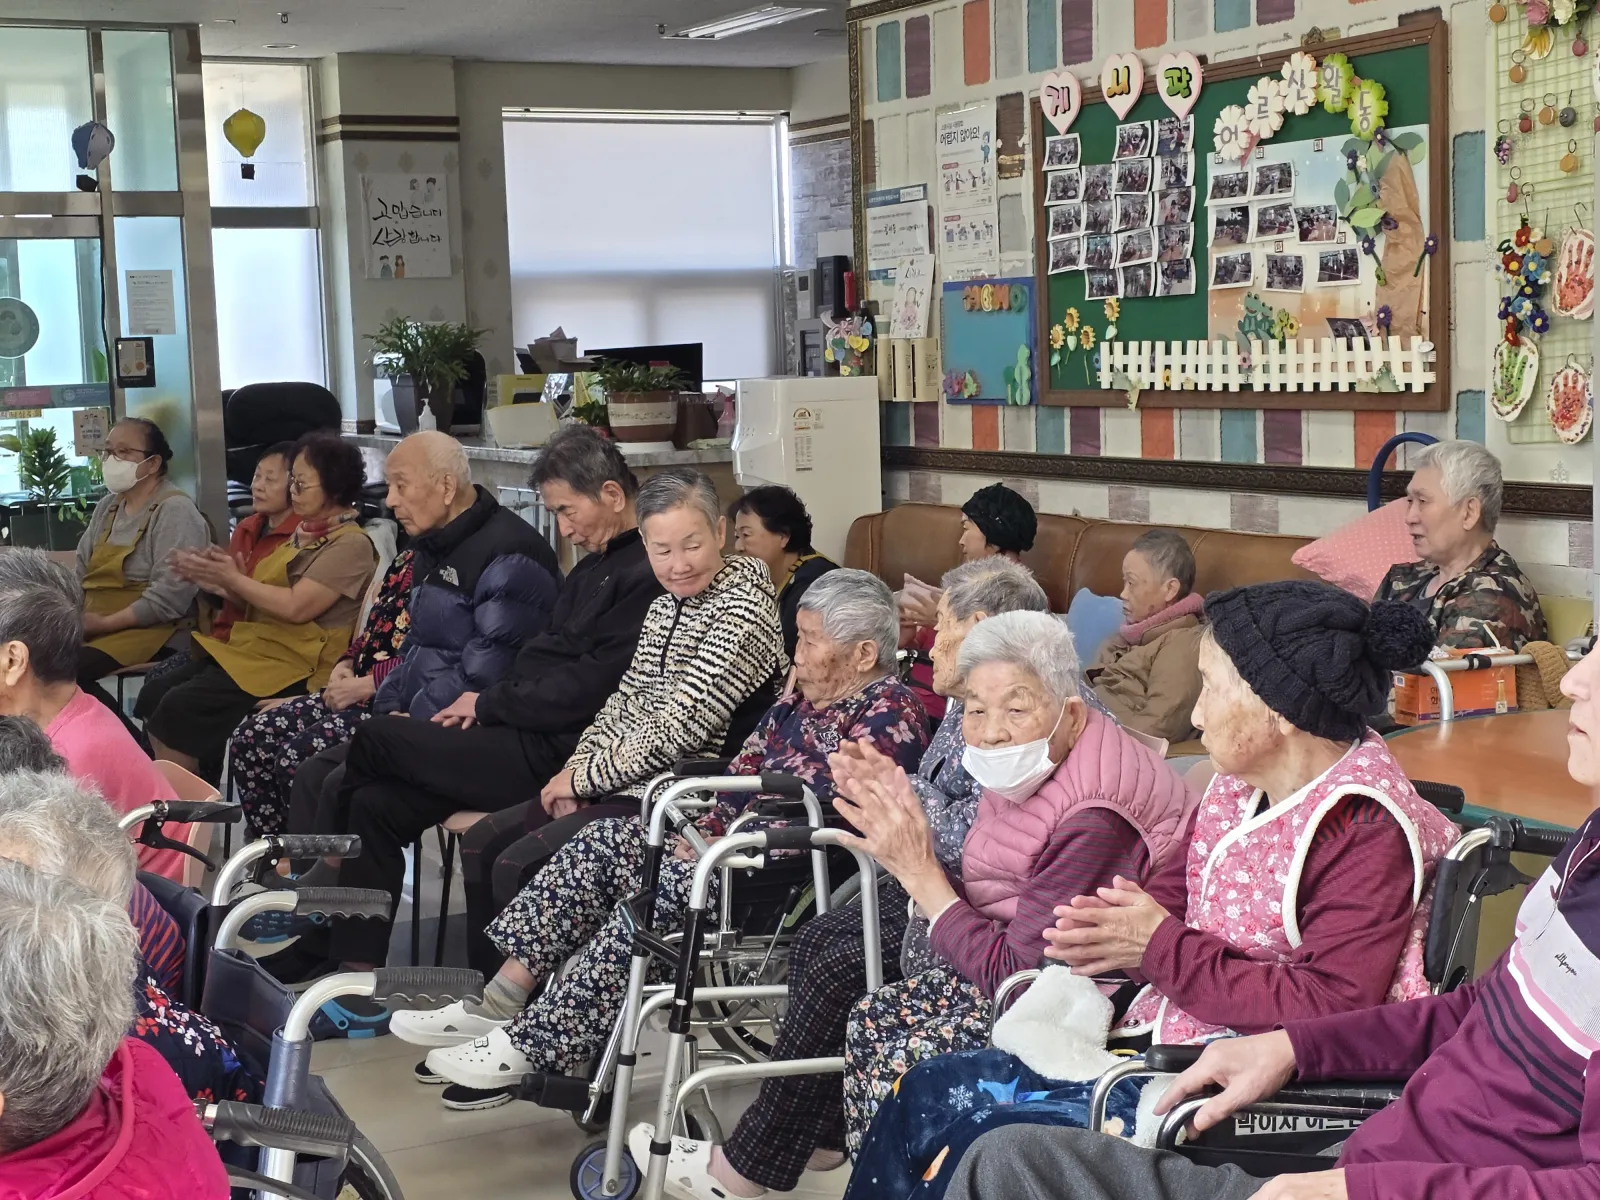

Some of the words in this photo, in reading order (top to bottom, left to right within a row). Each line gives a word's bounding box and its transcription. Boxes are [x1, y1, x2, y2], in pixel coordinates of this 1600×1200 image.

[1047, 66, 1192, 116] 게시판
[1220, 69, 1308, 145] 어르신
[1322, 64, 1372, 132] 활동
[372, 197, 442, 221] 고맙습니다
[372, 226, 442, 248] 사랑합니다
